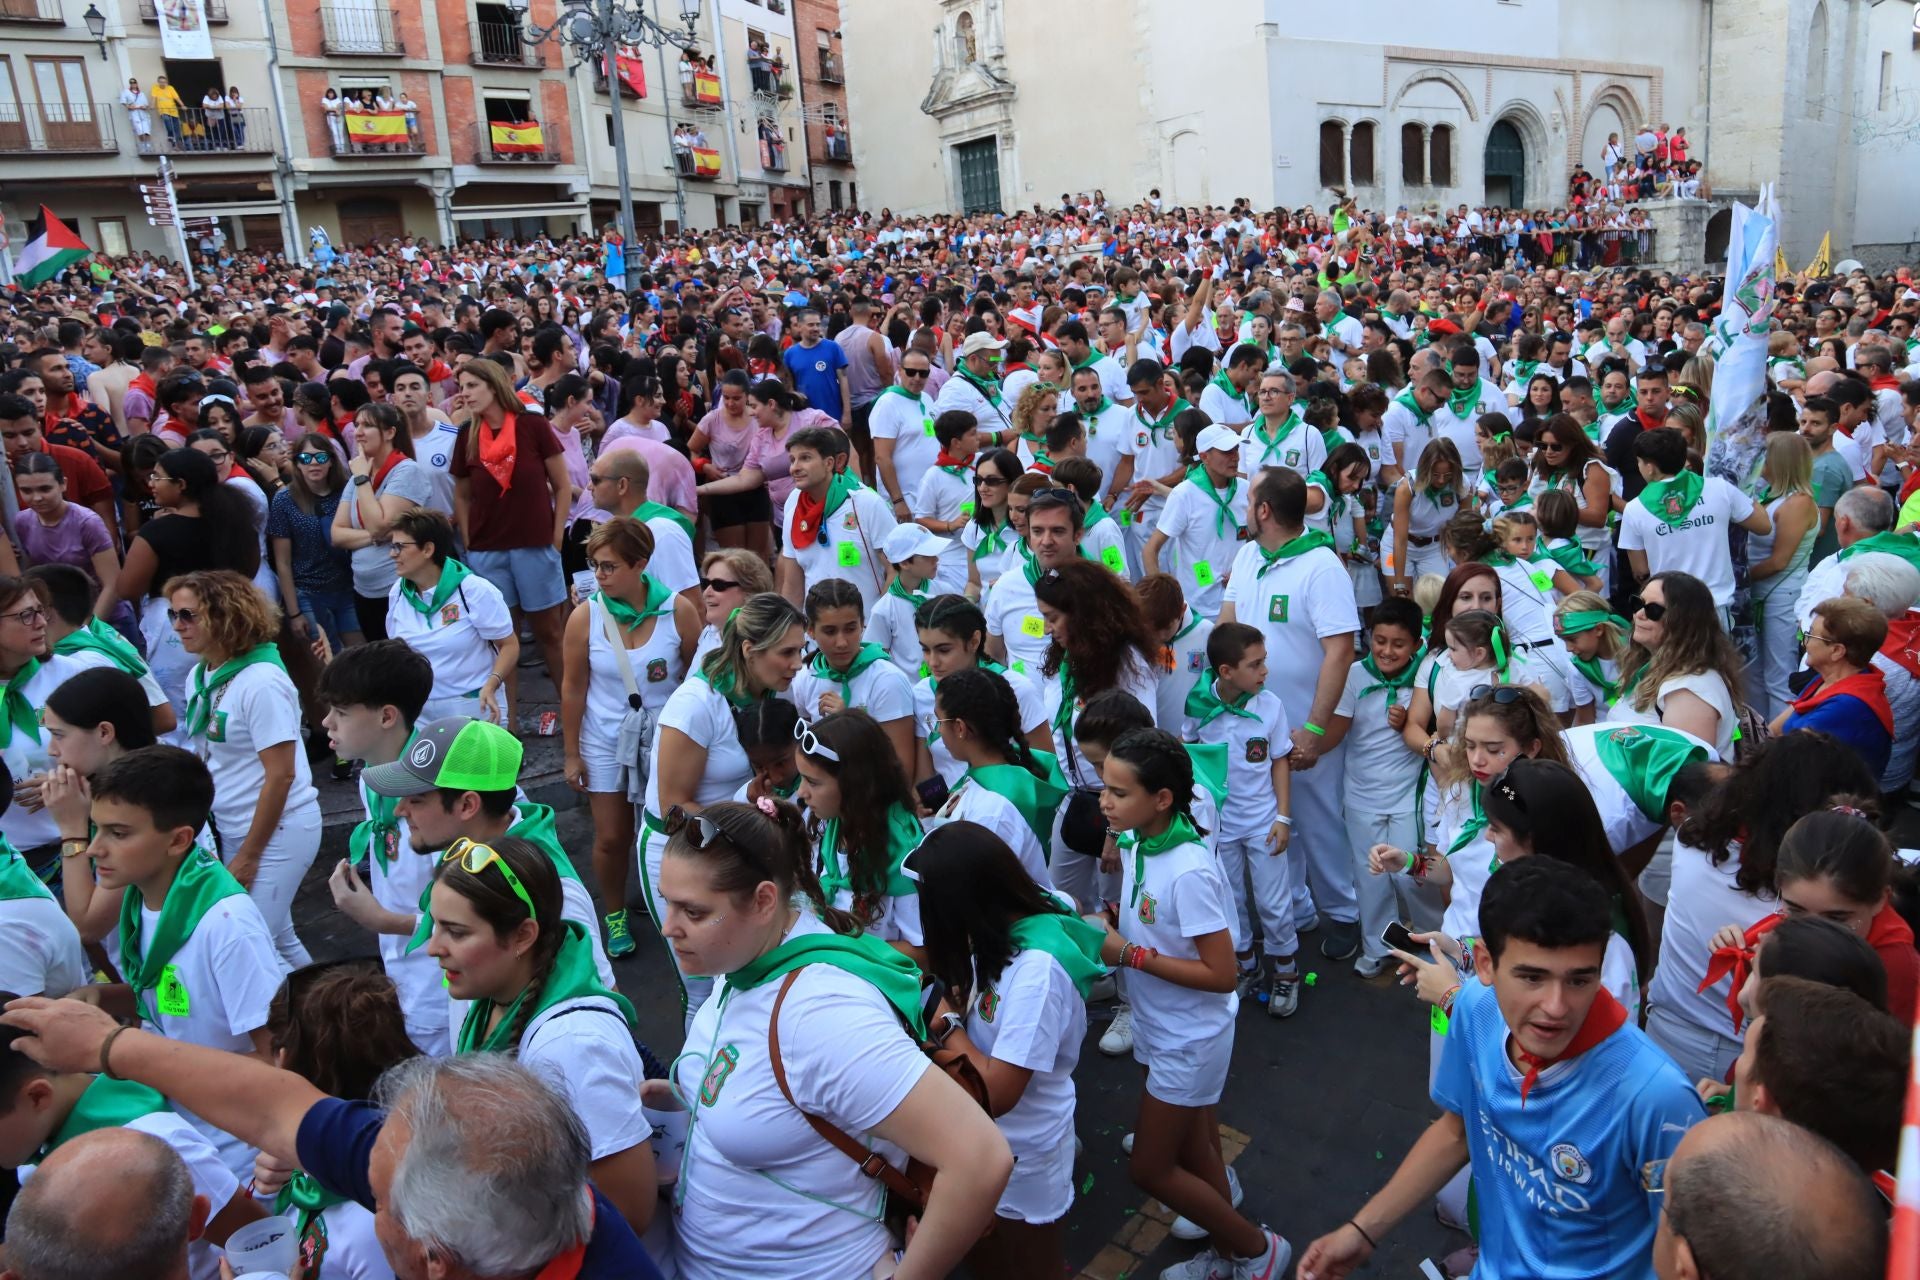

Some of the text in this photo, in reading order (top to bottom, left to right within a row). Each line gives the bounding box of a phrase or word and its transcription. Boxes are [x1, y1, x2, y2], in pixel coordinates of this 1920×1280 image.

[1655, 514, 1714, 537] El Soto
[1479, 1110, 1590, 1212] ETIHAD
[1487, 1145, 1559, 1218] AIRWAYS
